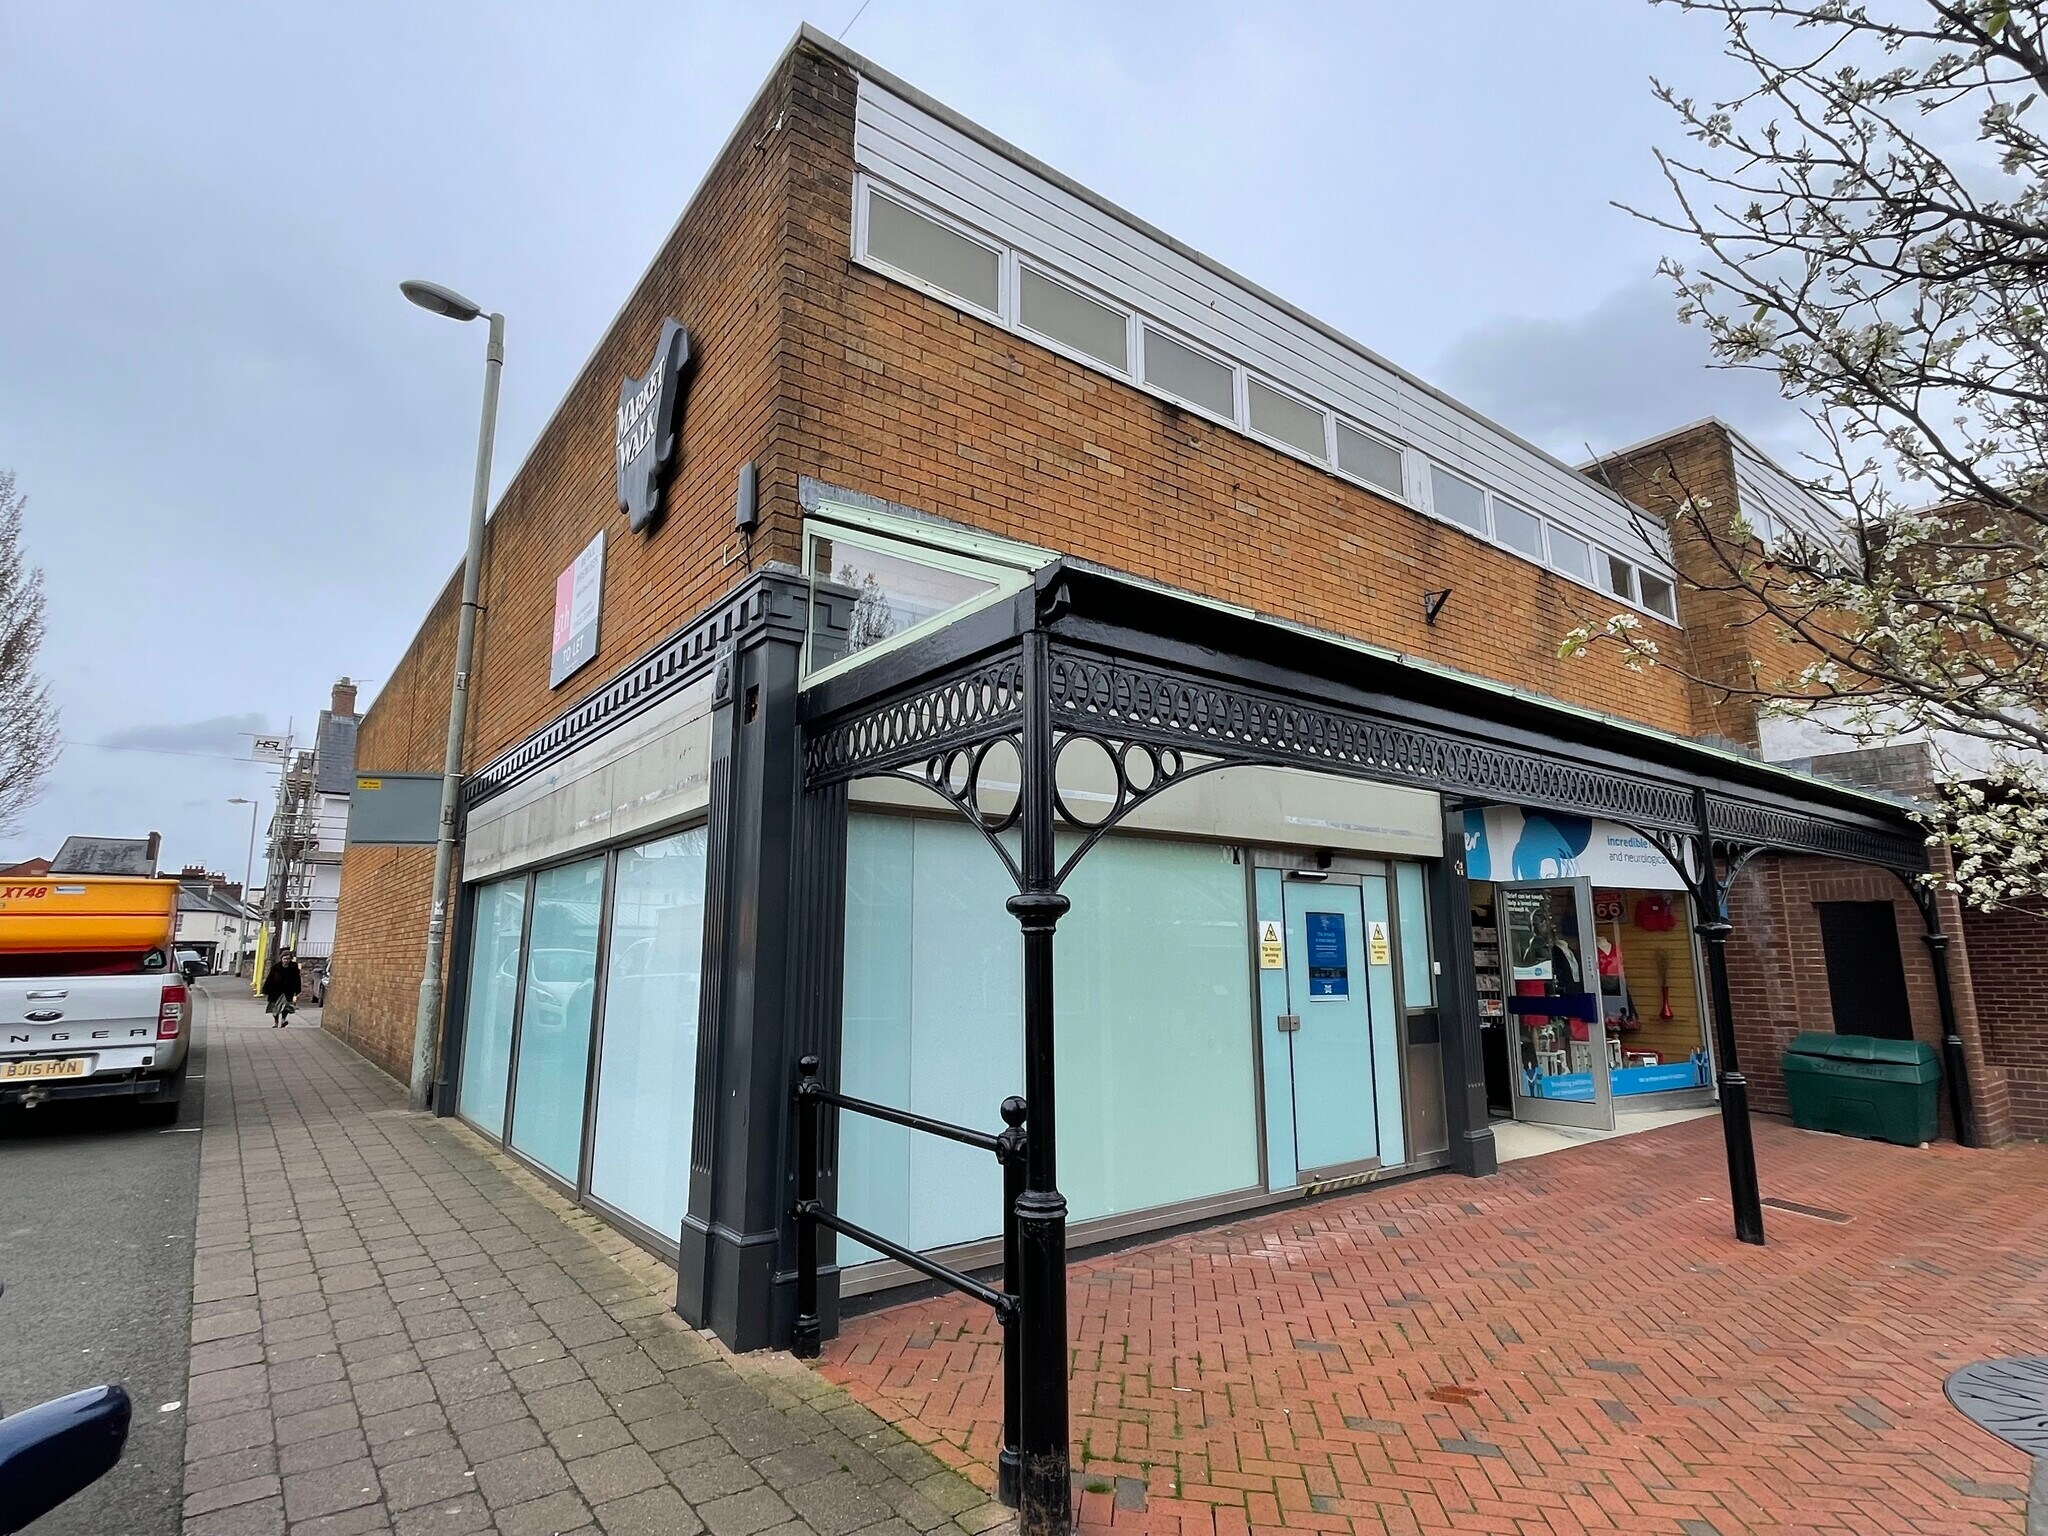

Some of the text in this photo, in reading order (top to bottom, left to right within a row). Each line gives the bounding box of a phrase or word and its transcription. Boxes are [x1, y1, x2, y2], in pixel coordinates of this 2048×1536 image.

[616, 355, 666, 447] MARKET
[619, 406, 656, 471] WALK
[562, 634, 585, 664] TO LET
[255, 740, 283, 751] HSL
[1607, 835, 1648, 849] incredible
[1609, 852, 1667, 867] and neurologica
[1, 887, 48, 899] XT48
[1596, 902, 1620, 917] 66
[10, 1028, 147, 1043] NGER
[7, 1061, 77, 1077] BJ15 HVN
